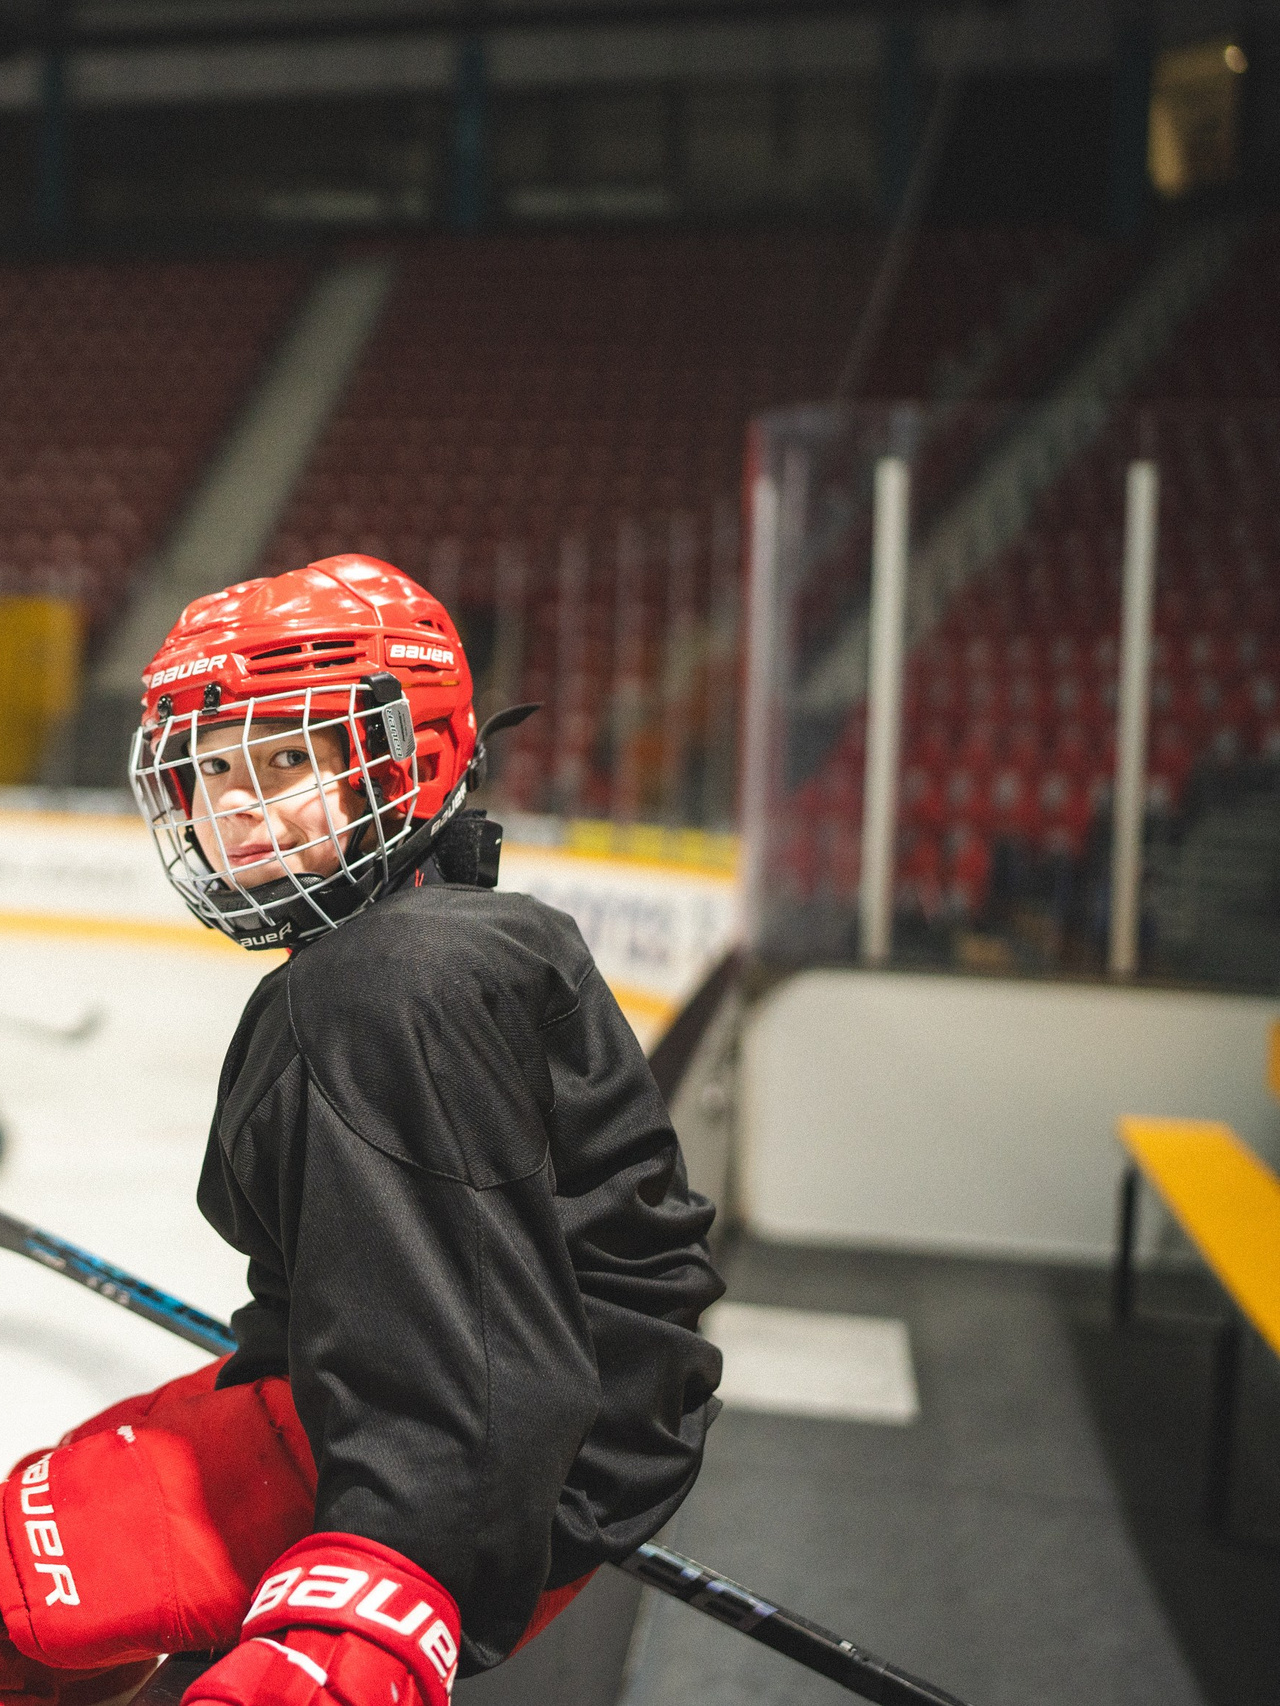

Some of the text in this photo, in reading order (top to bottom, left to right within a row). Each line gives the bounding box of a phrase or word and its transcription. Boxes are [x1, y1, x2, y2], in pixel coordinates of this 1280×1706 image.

[240, 921, 293, 947] AUER
[21, 1452, 81, 1606] AUER
[242, 1564, 458, 1698] BAUE
